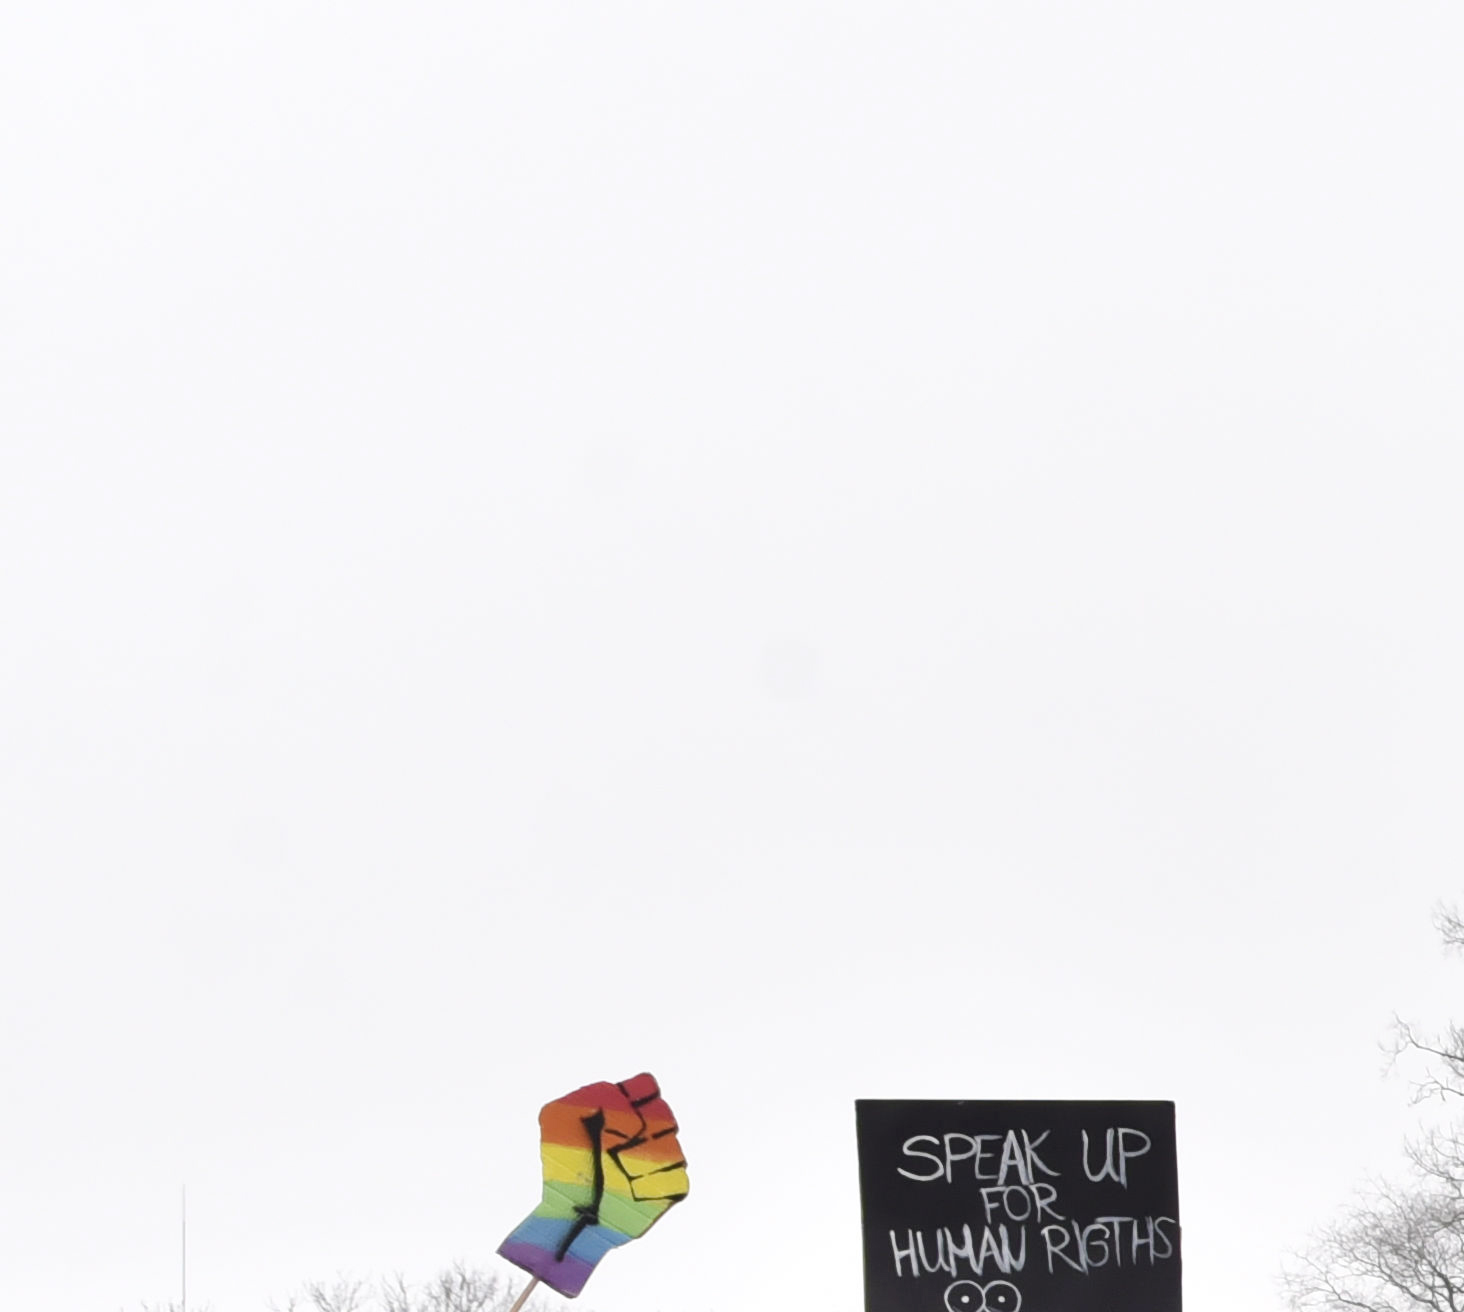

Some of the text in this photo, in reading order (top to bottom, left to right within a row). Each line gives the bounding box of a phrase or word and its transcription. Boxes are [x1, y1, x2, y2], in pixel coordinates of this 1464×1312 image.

[897, 1127, 1151, 1188] SPEAK UP
[980, 1183, 1065, 1223] FOR
[889, 1223, 1026, 1277] HUMAN
